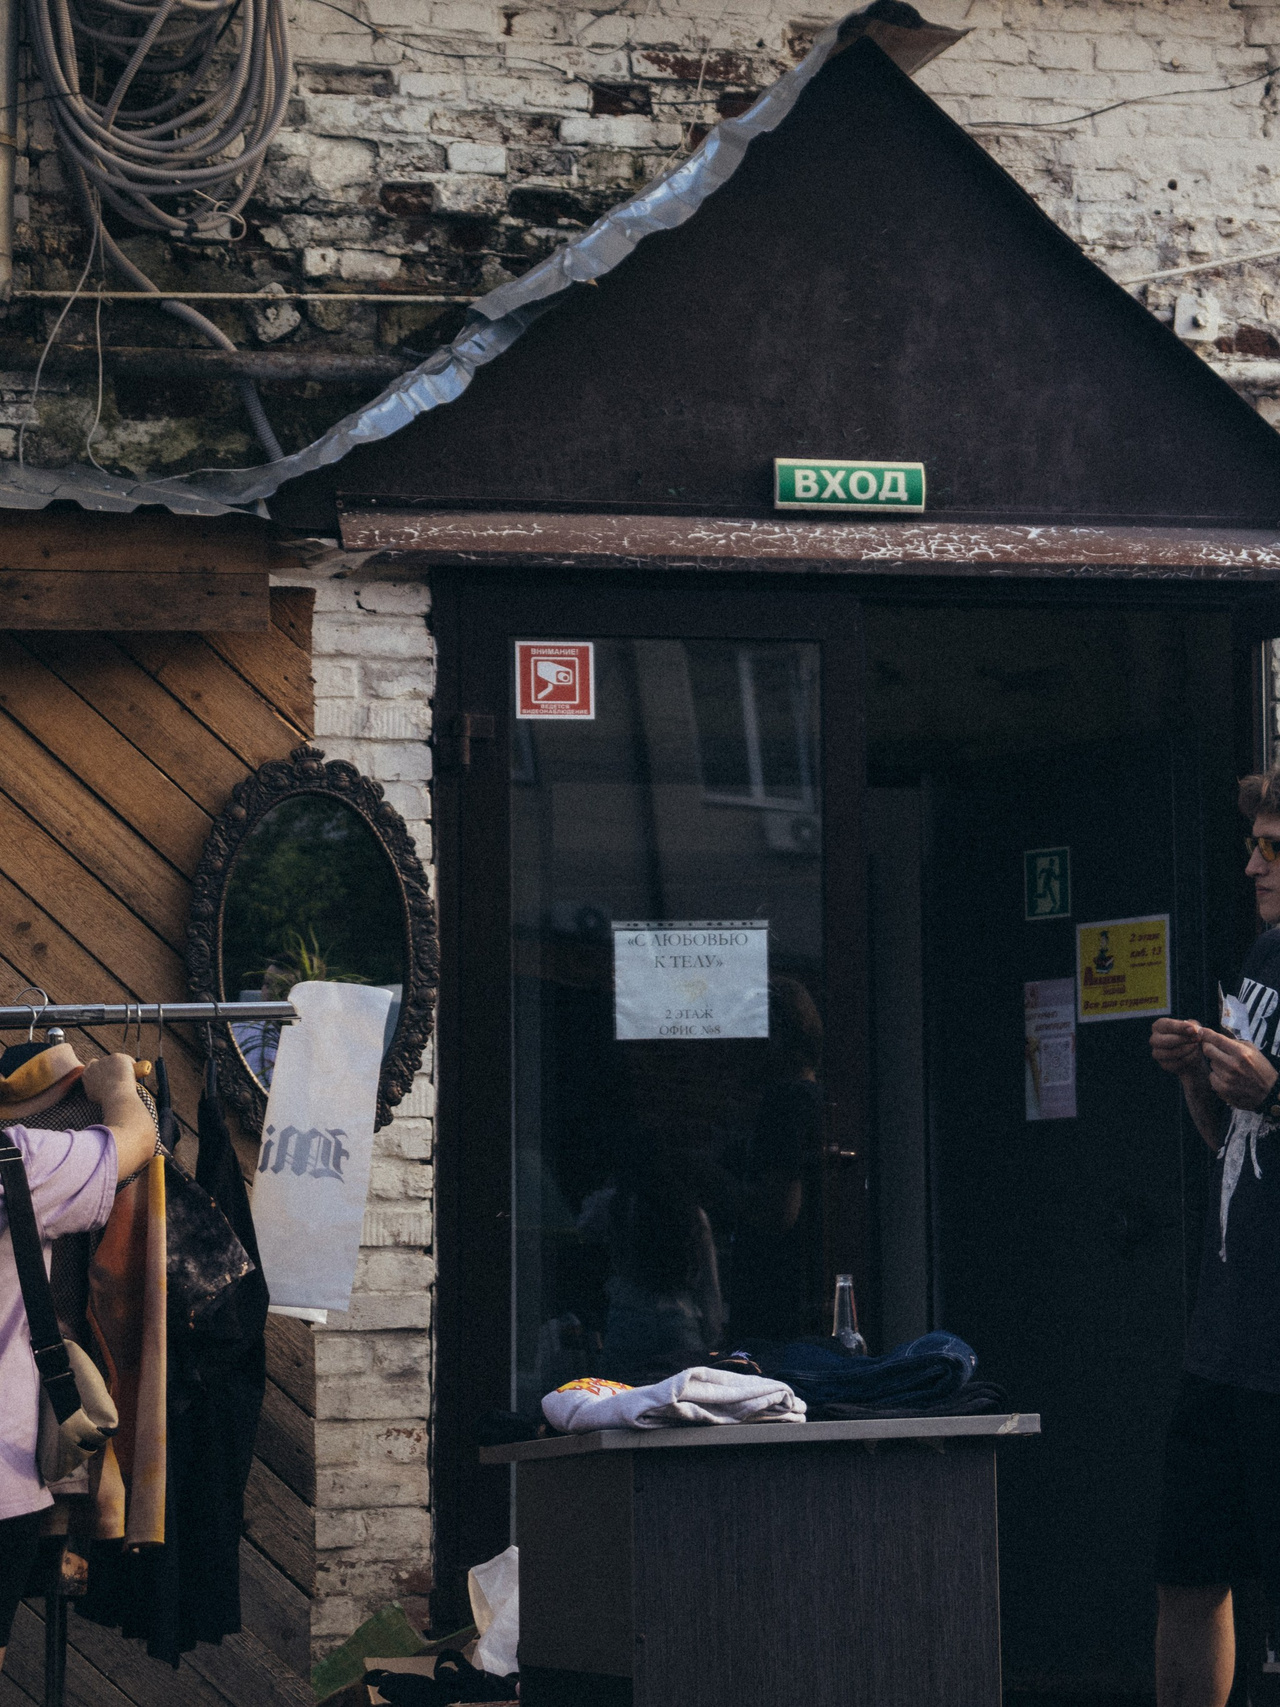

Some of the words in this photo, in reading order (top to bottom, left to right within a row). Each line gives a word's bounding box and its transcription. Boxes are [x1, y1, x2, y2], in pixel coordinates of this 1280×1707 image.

[794, 469, 908, 501] ВХОД
[530, 648, 579, 656] ВНИМАНИЕ!
[652, 933, 748, 947] ЛЮБОВЬЮ
[1130, 933, 1137, 943] 2
[654, 956, 665, 968] К
[669, 955, 724, 969] ТЕЛУ»
[665, 1009, 673, 1019] 2
[674, 1009, 714, 1019] ЭТАЖ
[659, 1025, 698, 1036] ОФИС
